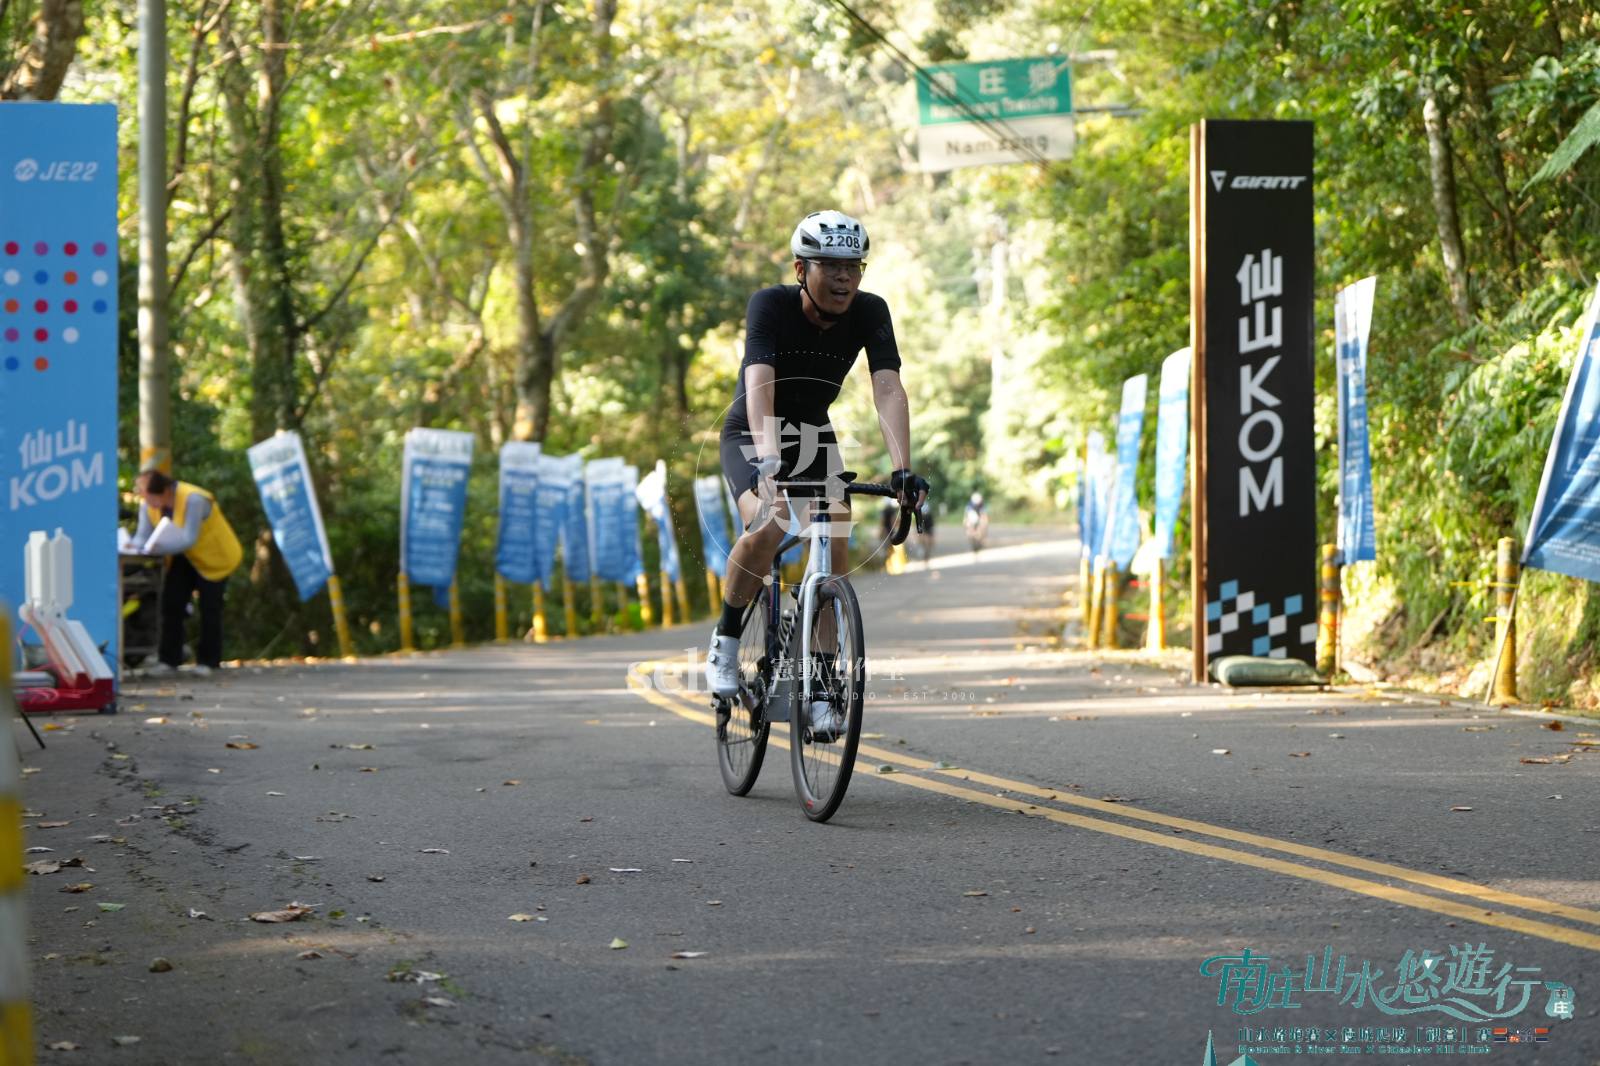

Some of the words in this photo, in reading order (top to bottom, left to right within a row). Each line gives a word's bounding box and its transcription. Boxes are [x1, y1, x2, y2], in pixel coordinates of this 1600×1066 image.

[39, 161, 98, 181] JE22
[1231, 175, 1307, 190] GIANT
[825, 235, 860, 249] 2208
[19, 419, 87, 469] 仙山
[10, 452, 104, 510] KOM
